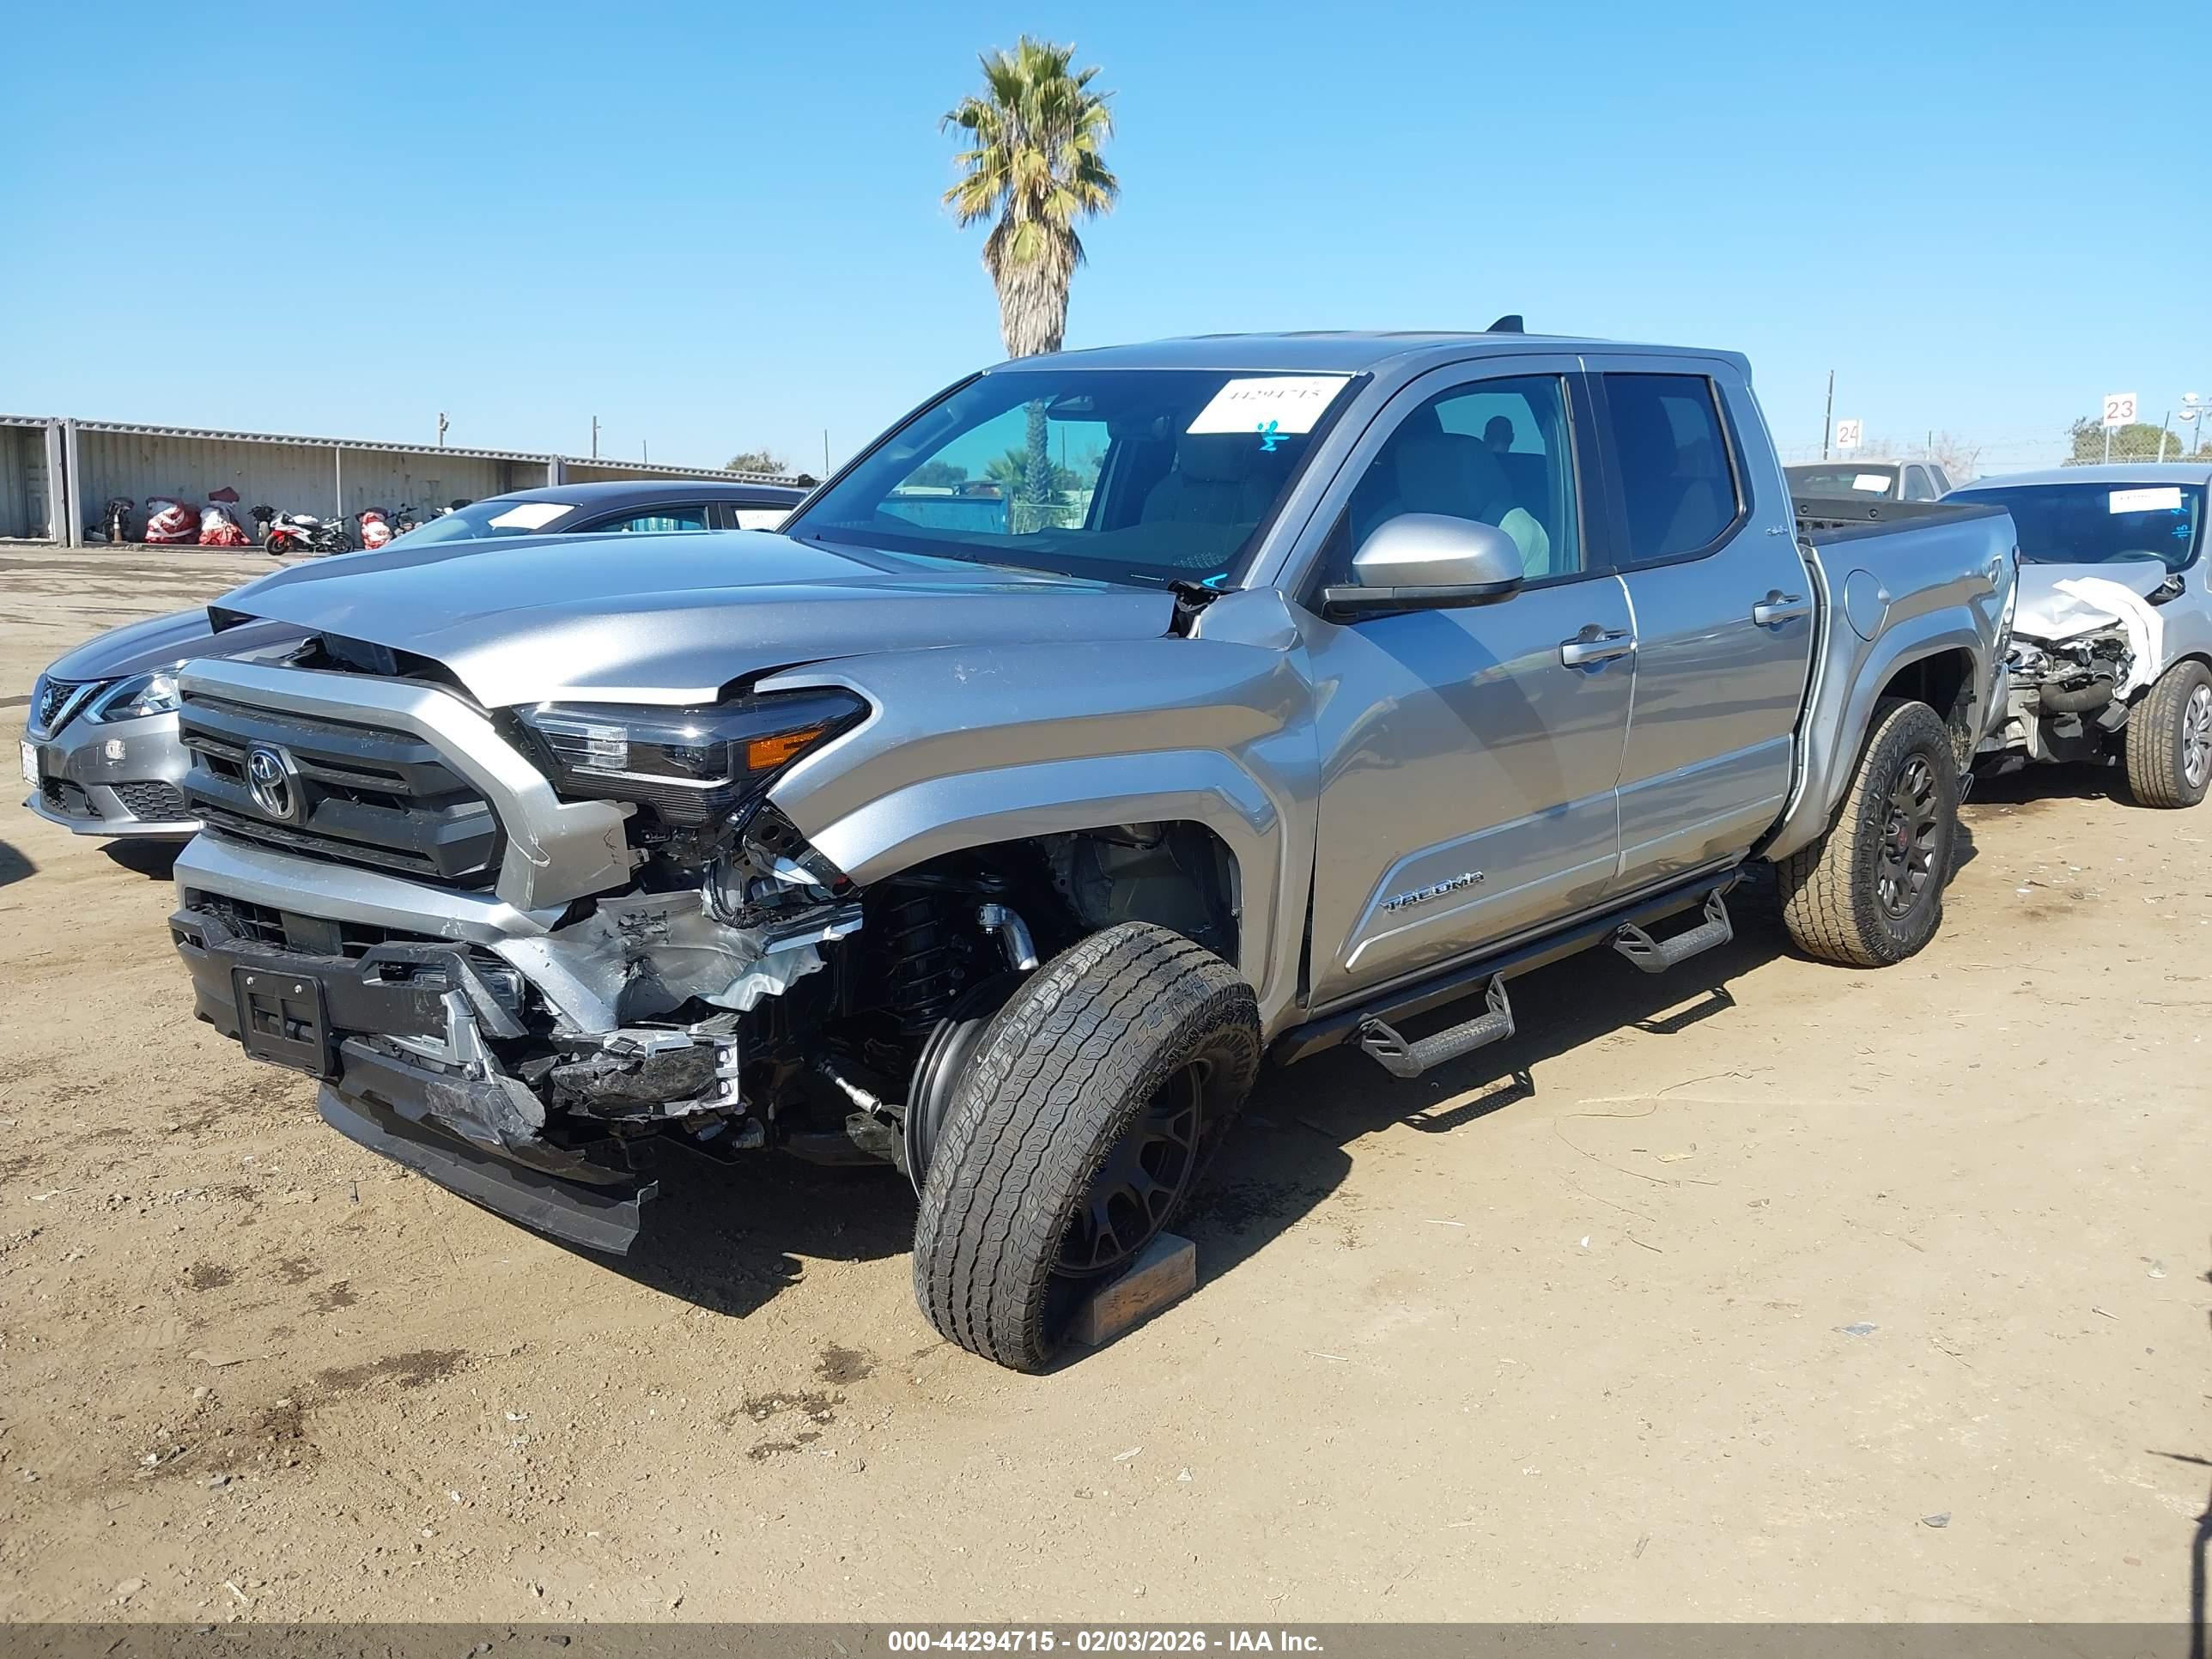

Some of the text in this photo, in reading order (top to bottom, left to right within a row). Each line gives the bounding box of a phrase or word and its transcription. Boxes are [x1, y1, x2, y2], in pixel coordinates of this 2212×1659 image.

[2107, 400, 2133, 419] 23
[1839, 425, 1858, 442] 24
[1379, 871, 1484, 912] TACOMA
